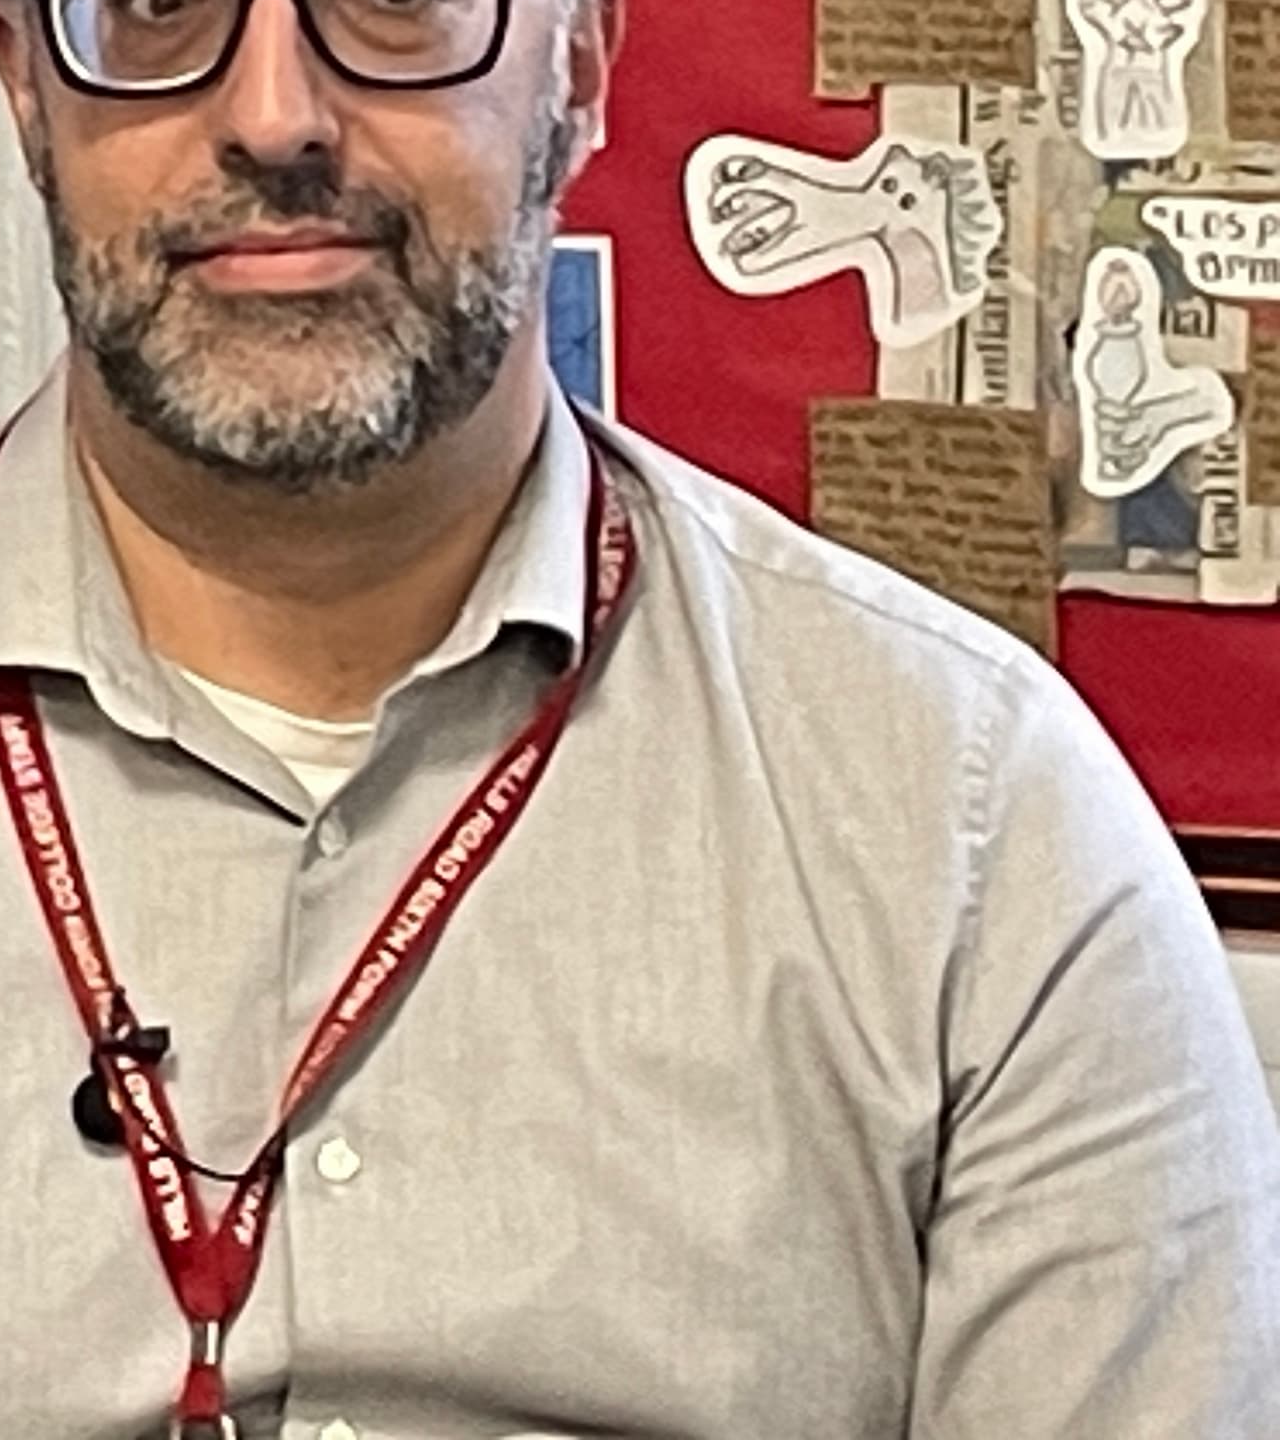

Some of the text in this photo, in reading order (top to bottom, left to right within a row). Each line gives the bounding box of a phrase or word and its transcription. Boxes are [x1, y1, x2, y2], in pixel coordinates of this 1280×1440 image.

[19, 789, 78, 914] COLLEGE
[436, 809, 498, 886] ROAD
[63, 914, 102, 991] FORM
[387, 879, 450, 957] SIXTH
[341, 951, 400, 1027] FORM
[141, 1157, 193, 1242] HILLS
